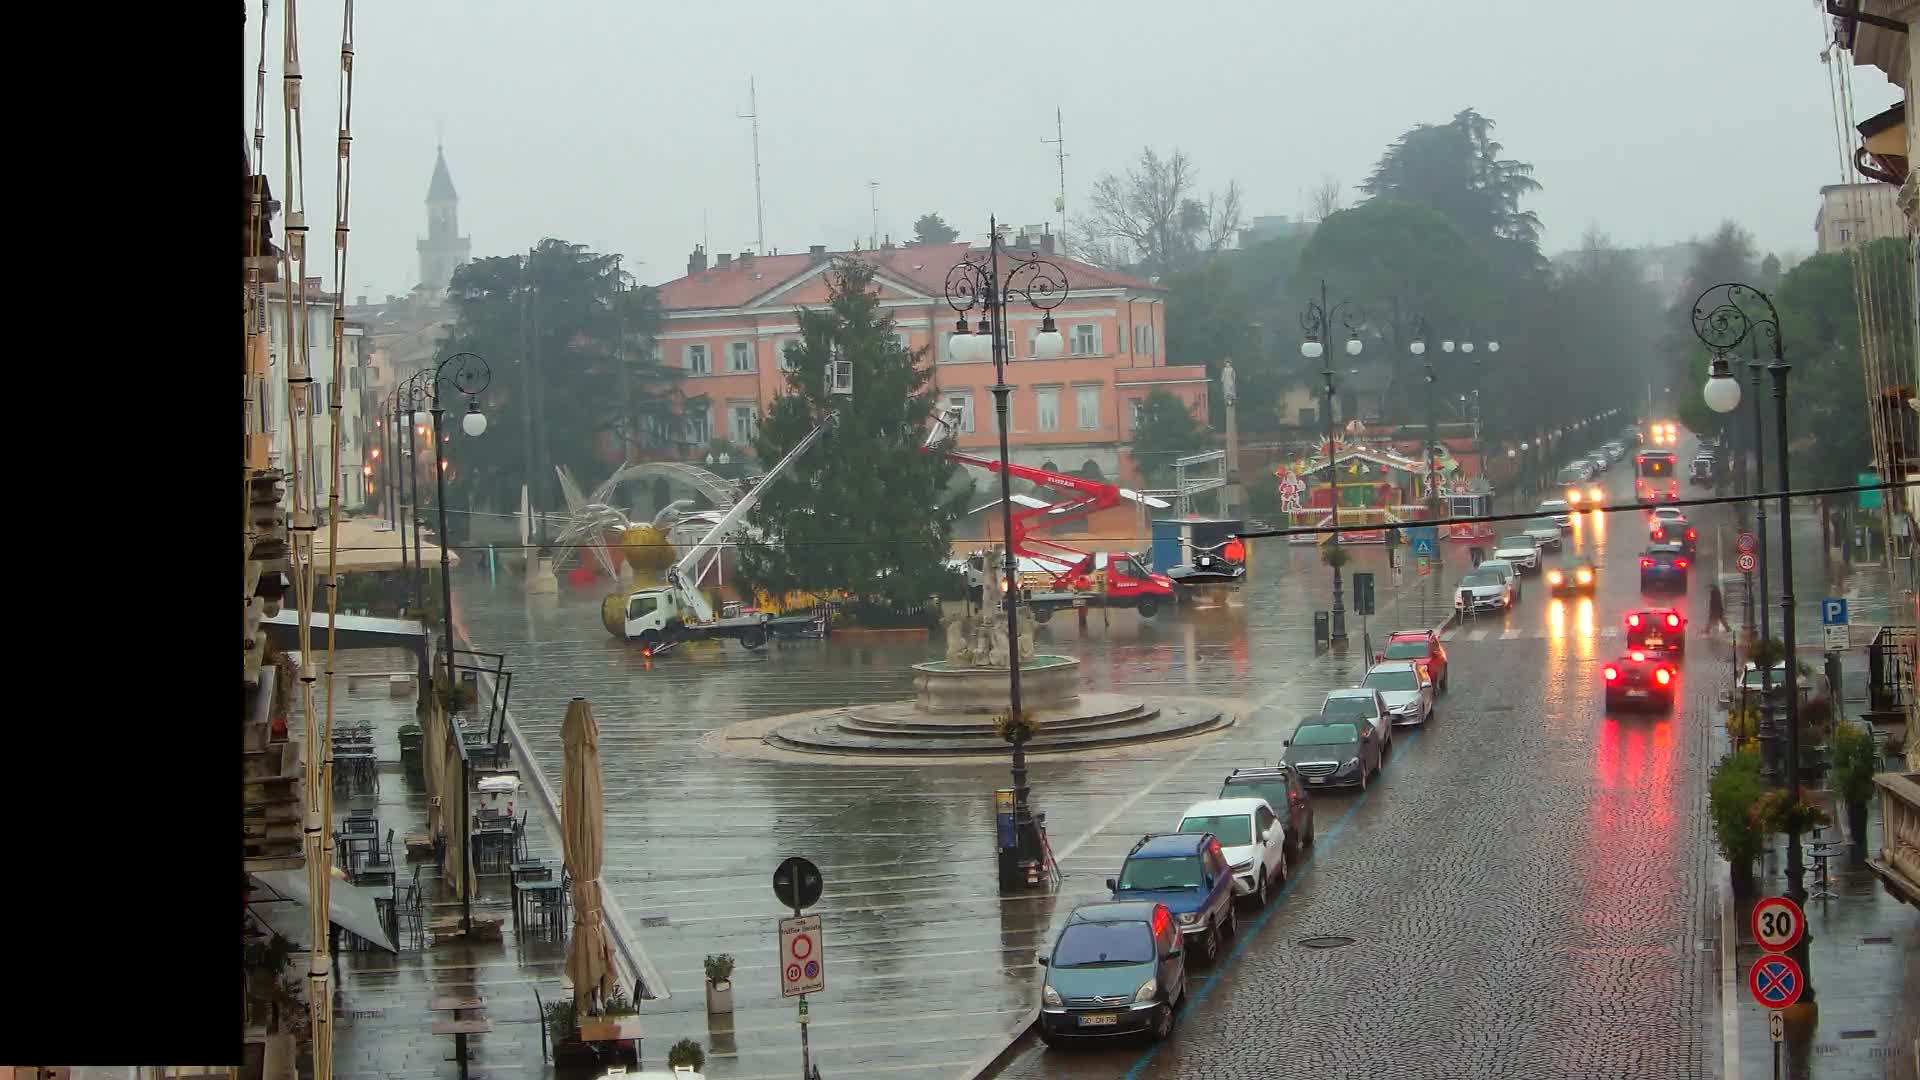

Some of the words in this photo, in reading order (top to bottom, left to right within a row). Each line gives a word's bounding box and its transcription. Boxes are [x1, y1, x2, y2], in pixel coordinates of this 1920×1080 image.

[1742, 557, 1752, 567] 20
[1827, 602, 1841, 622] P
[1762, 911, 1791, 937] 30
